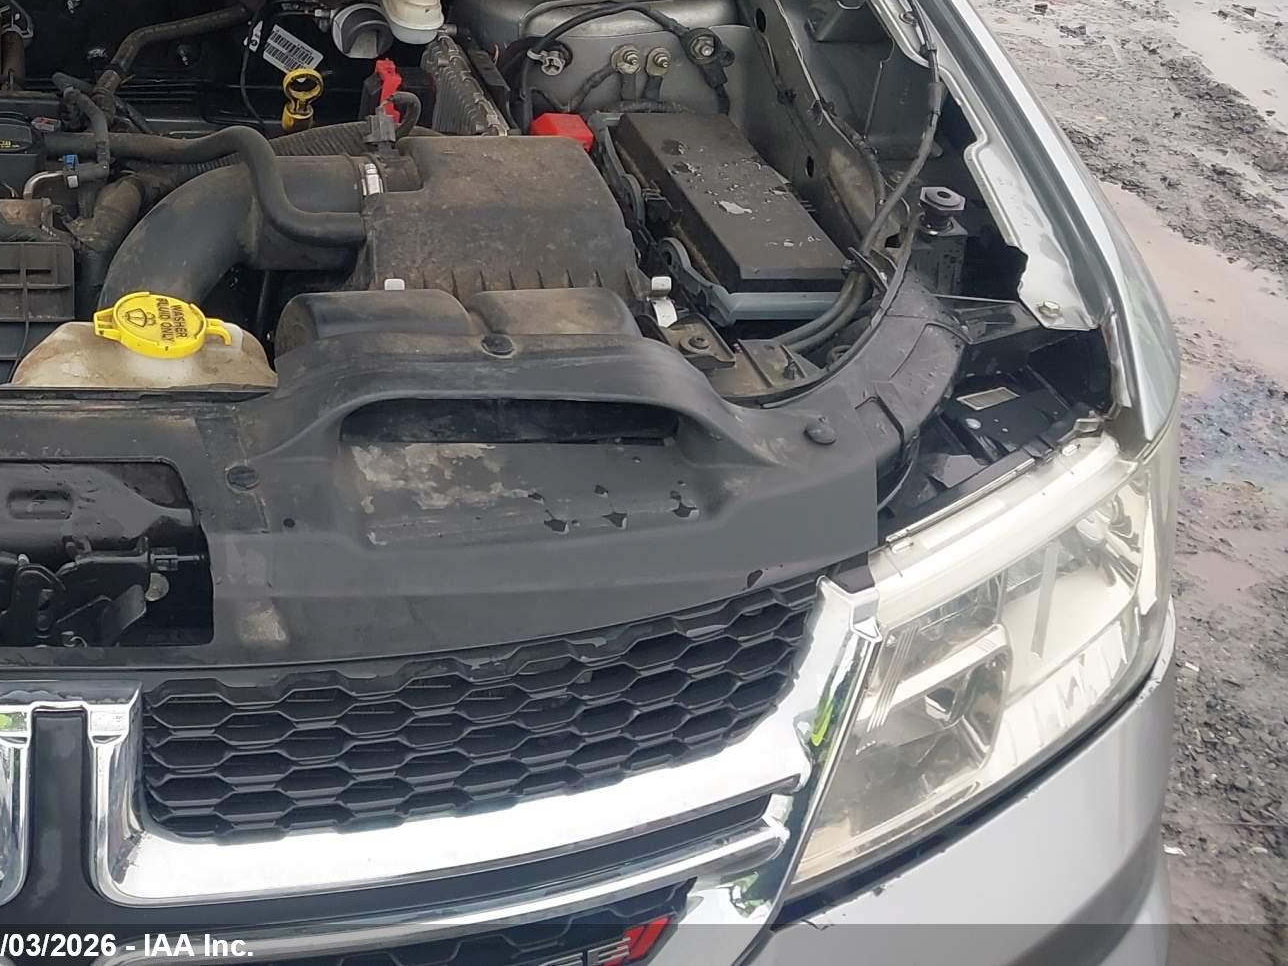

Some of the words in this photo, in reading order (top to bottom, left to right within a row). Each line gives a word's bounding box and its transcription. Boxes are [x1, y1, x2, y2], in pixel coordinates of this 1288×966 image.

[155, 297, 171, 324] FLUID
[171, 304, 188, 339] WASHER
[160, 322, 175, 343] ONLY
